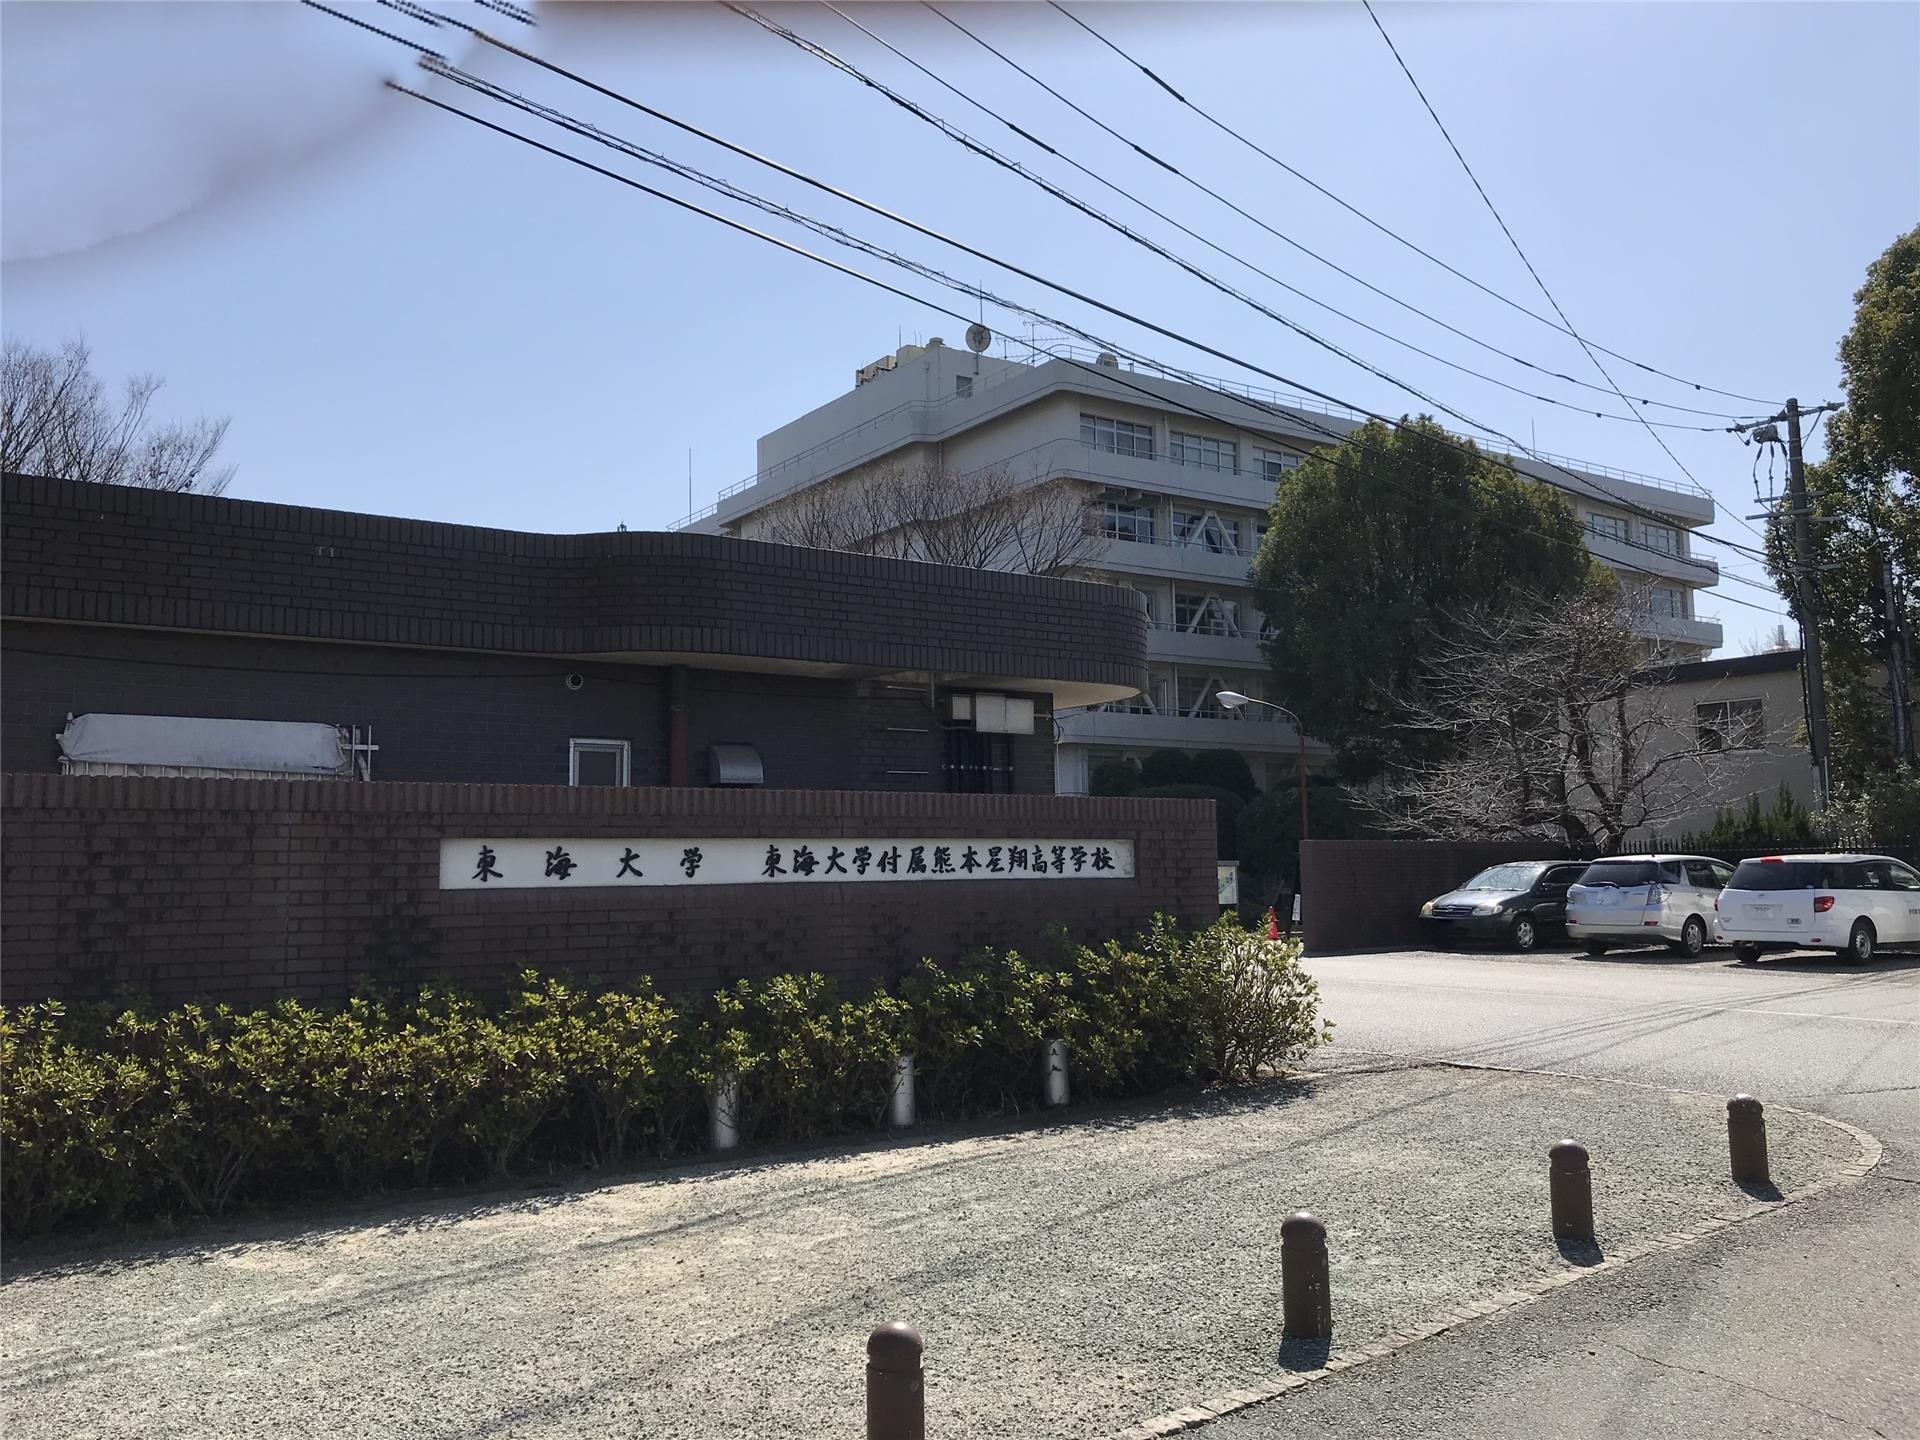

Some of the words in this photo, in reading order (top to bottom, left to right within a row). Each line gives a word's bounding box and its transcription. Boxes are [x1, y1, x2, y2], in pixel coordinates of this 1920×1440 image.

[471, 844, 704, 883] 東海大学
[760, 843, 1117, 879] 東海大学付属熊本星翔高等学校
